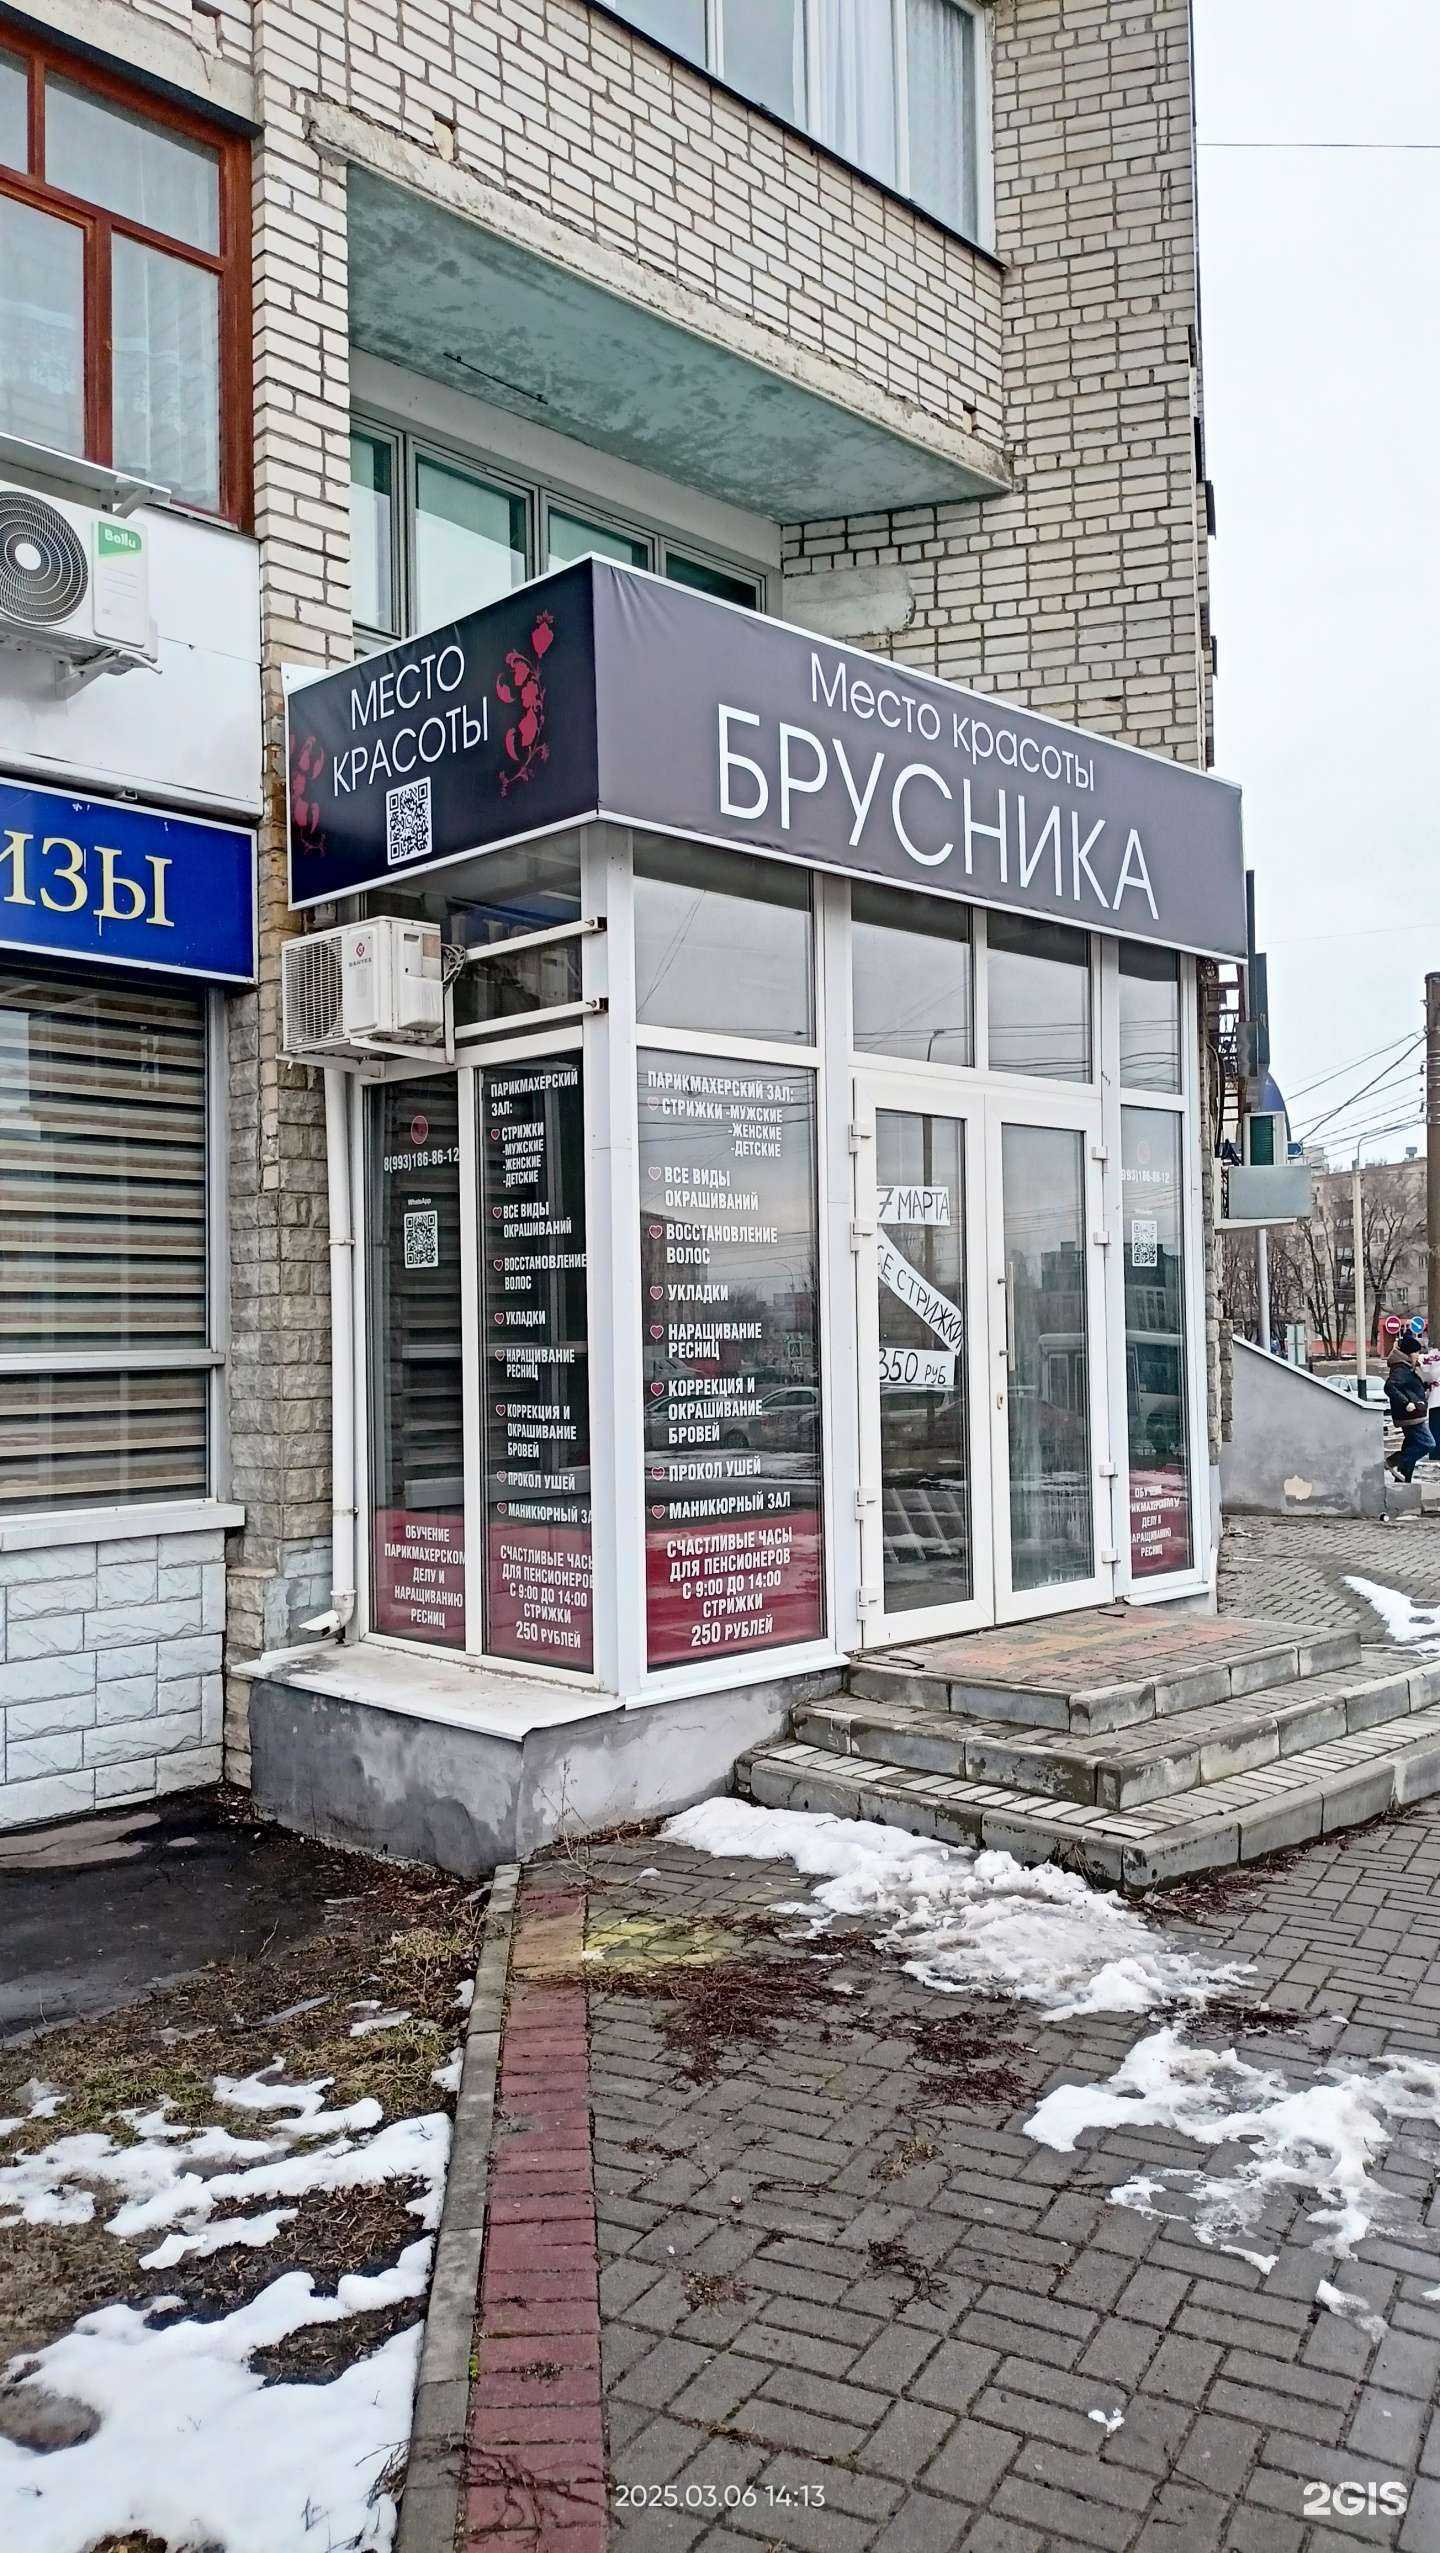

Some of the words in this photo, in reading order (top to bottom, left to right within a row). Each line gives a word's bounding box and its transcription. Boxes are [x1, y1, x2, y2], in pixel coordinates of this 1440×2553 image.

[351, 645, 465, 730] МЕСТО
[810, 652, 940, 740] Место
[953, 712, 1095, 791] красоты
[333, 696, 488, 797] КРАСОТЫ
[717, 703, 1160, 921] БРУСНИКА
[491, 1068, 578, 1097] ПАРИКМАХЕРСКИЙ
[647, 1070, 763, 1098] ПАРИКМАХЕРСКИЙ
[766, 1084, 794, 1102] ЗАЛ:
[491, 1101, 513, 1117] ЗАЛ:
[662, 1099, 723, 1119] СТРИЖКИ
[501, 1122, 544, 1141] СТРИЖКИ
[664, 1167, 689, 1184] ВСЕ
[693, 1169, 730, 1188] ВИДЫ
[665, 1189, 759, 1210] ОКРАШИВАНИЙ
[877, 1187, 895, 1218] 7
[898, 1188, 949, 1221] МАРТА
[503, 1204, 519, 1219] ВСЕ
[520, 1202, 549, 1218] ВИДЫ
[503, 1217, 572, 1238] ОКРАШИВАНИЙ
[666, 1223, 778, 1243] ВОССТАНОВЛЕНИЕ
[504, 1254, 587, 1271] ВОССТАНОВЛЕНИЕ
[666, 1247, 711, 1264] ВОЛОС
[505, 1276, 532, 1291] ВОЛОС
[668, 1284, 729, 1303] УКЛАДКИ
[505, 1311, 545, 1325] УКЛАДКИ
[668, 1323, 762, 1343] НАРАЩИВАНИЕ
[506, 1348, 575, 1365] НАРАЩИВАНИЕ
[668, 1341, 720, 1360] РЕСНИЦ
[506, 1364, 539, 1380] РЕСНИЦ
[669, 1378, 743, 1397] КОРРЕКЦИЯ
[747, 1377, 755, 1393] И
[507, 1404, 560, 1421] КОРРЕКЦИЯ
[563, 1406, 570, 1418] И
[669, 1400, 762, 1420] ОКРАШИВАНИЕ
[507, 1423, 577, 1440] ОКРАШИВАНИЕ
[669, 1422, 720, 1444] БРОВЕЙ
[508, 1441, 539, 1458] БРОВЕЙ
[669, 1461, 722, 1482] ПРОКОЛ
[726, 1455, 761, 1477] УШЕЙ
[508, 1471, 541, 1488] ПРОКОЛ
[544, 1473, 575, 1490] УШЕЙ
[508, 1502, 578, 1524] МАНИКЮРНЫЙ
[669, 1490, 763, 1520] МАНИКЮРНЫЙ
[767, 1491, 791, 1510] ЗАЛ
[405, 1525, 450, 1542] ОБУЧЕНИЕ
[667, 1530, 755, 1558] СЧАСТЛИВЫЕ
[758, 1526, 793, 1547] ЧАСЫ
[500, 1545, 564, 1567] СЧАСТЛИВЫЕ
[670, 1561, 700, 1582] ДЛЯ
[704, 1548, 791, 1575] ПЕНСИОНЕРОВ
[413, 1567, 437, 1584] ДЕЛУ
[439, 1570, 445, 1584] И
[502, 1563, 521, 1580] ДЛЯ
[682, 1582, 691, 1599] С
[696, 1579, 723, 1598] 9:00
[726, 1575, 744, 1596] ДО
[748, 1569, 781, 1589] 14:00
[395, 1586, 463, 1607] НАРАЩИВАНИЮ
[510, 1583, 516, 1597] С
[518, 1584, 538, 1600] 9:00
[540, 1587, 555, 1603] ДО
[558, 1590, 587, 1607] 14:00
[524, 1603, 571, 1624] СТРИЖКИ
[703, 1593, 763, 1618] СТРИЖКИ
[411, 1608, 446, 1628] РЕСНИЦ
[516, 1621, 538, 1641] 250
[541, 1627, 581, 1648] РУБЛЕЙ
[691, 1622, 721, 1647] 250
[725, 1614, 773, 1641] РУБЛЕЙ
